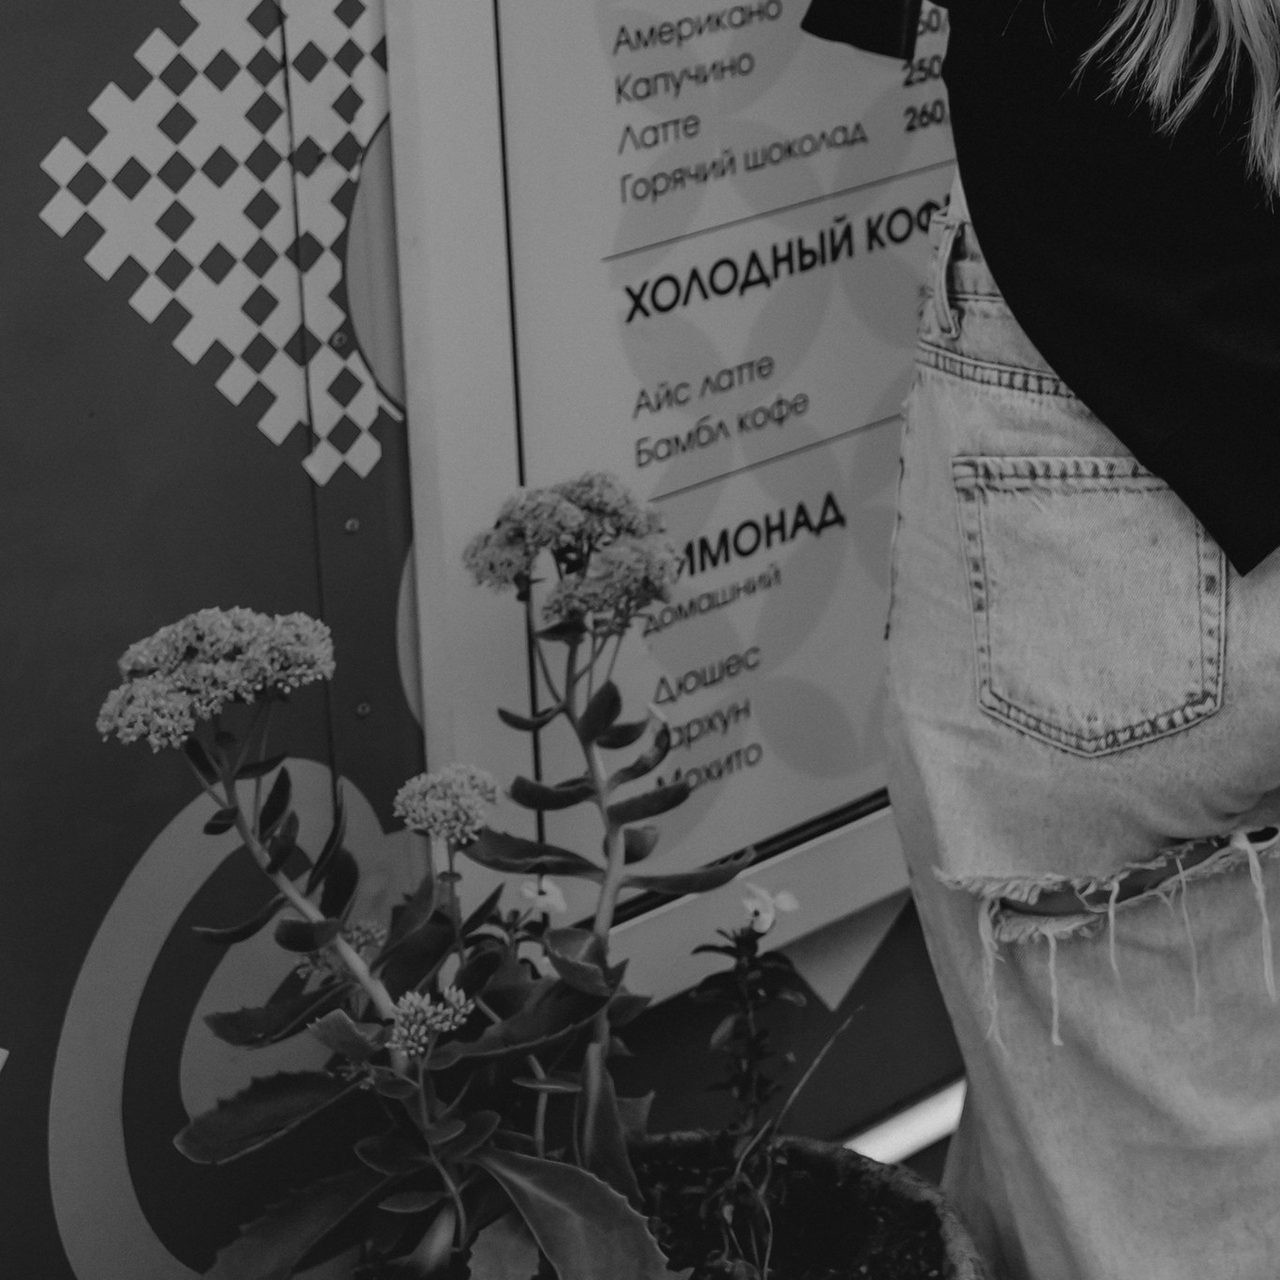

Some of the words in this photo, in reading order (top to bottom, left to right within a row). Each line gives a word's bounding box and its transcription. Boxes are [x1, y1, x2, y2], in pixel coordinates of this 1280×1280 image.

[614, 52, 755, 105] Капучино
[617, 113, 700, 156] Латте
[901, 53, 942, 87] 250
[618, 148, 737, 204] Горячий
[743, 121, 870, 173] шоколад
[904, 98, 945, 132] 260
[624, 215, 855, 323] ХОЛОДНЫЙ
[866, 194, 951, 253] КОФ
[632, 381, 691, 419] Айс
[700, 355, 776, 400] латте
[633, 415, 731, 469] Бамбл
[737, 392, 810, 429] кофе
[671, 491, 846, 583] ИМОНАД
[654, 646, 761, 705] Дюшес
[670, 697, 751, 750] архун
[657, 742, 764, 791] охито
